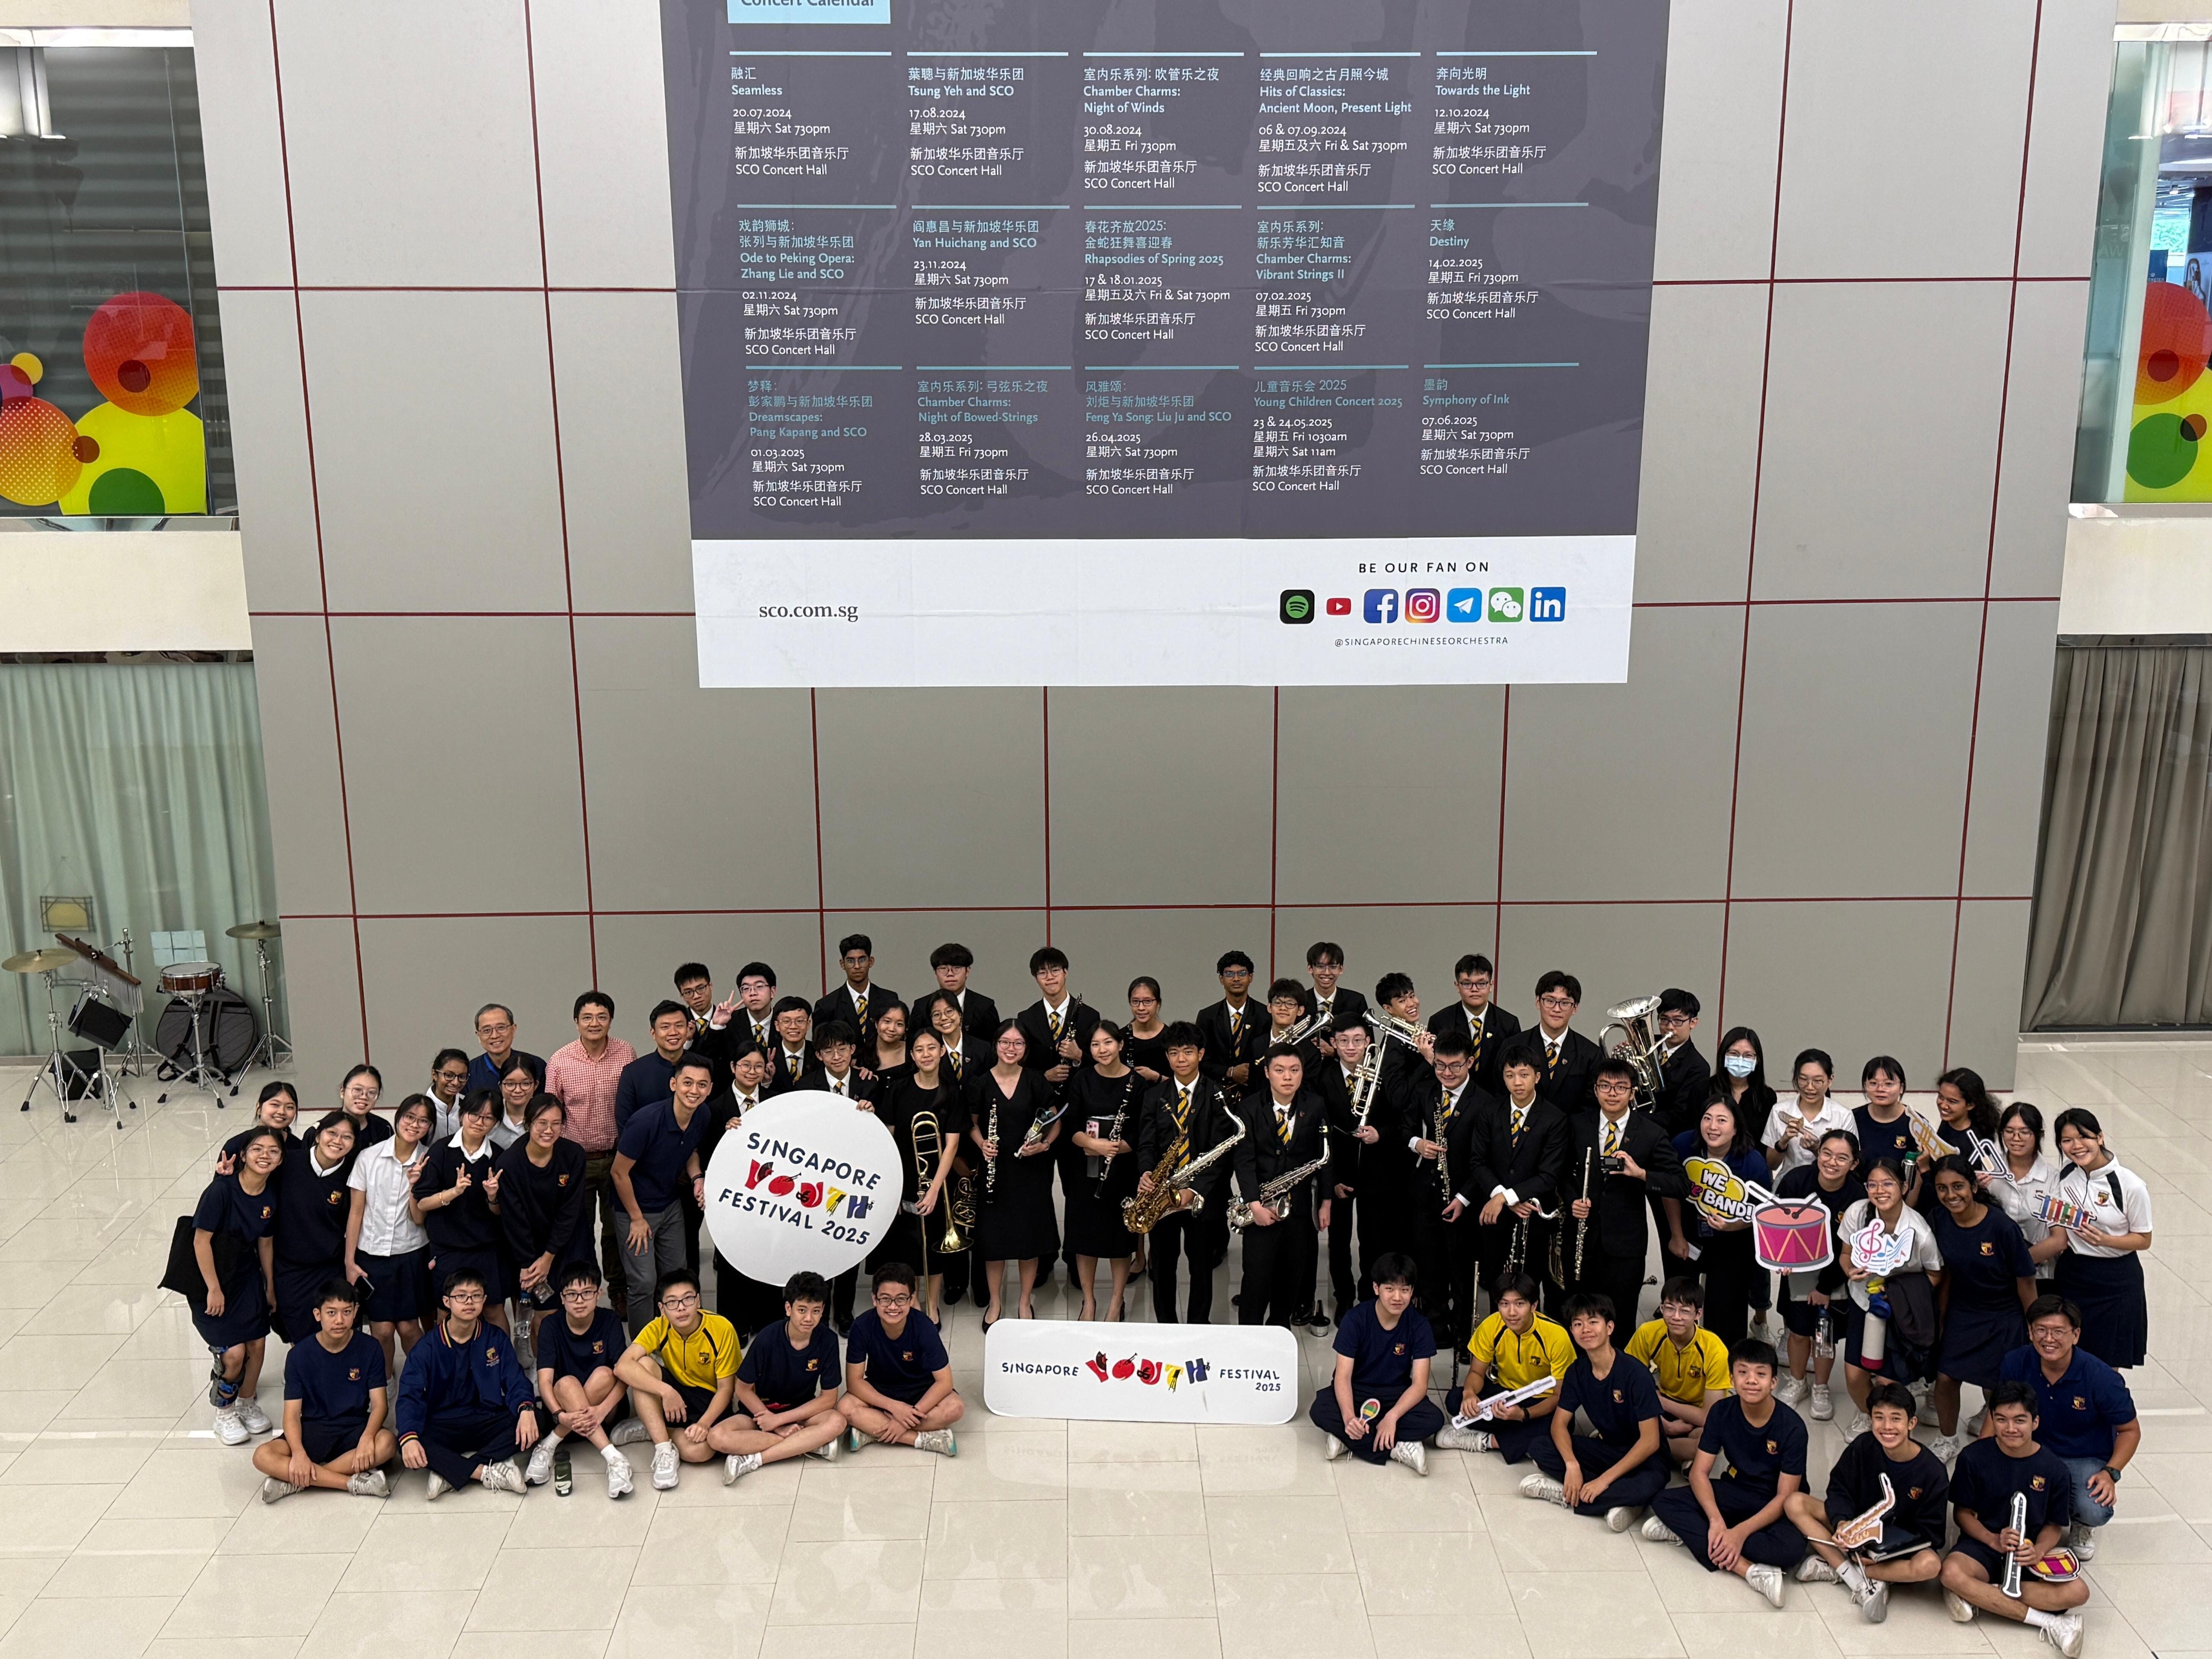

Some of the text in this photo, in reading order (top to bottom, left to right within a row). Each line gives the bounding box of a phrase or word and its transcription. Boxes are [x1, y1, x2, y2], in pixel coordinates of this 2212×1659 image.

[731, 67, 757, 80] 融汇
[1260, 67, 1389, 81] 经典回响之古月照今城
[1436, 67, 1487, 81] 奔向光明
[731, 83, 782, 95] Seamless
[908, 84, 1014, 99] Tsung Yeh and SCO
[1083, 85, 1180, 96] Chamber Charms:
[1260, 85, 1345, 97] Hits of Classics:
[1435, 83, 1531, 98] Towards the Light
[733, 109, 792, 120] 20.07.2024
[909, 107, 966, 121] 17.08.2024
[1084, 101, 1165, 116] Night of Winds
[1259, 101, 1412, 116] Ancient Moon, Present Light
[1435, 109, 1490, 120] 12.10.2024
[1084, 124, 1142, 137] 30.08.2024
[1259, 123, 1347, 137] 06 & 07.09.2024
[1084, 138, 1176, 154] 星期五 Fri 730pm
[1259, 138, 1407, 153] 星期五及六 Fri & Sat 730pm
[735, 146, 849, 160] 新加坡华乐团音乐厅
[736, 163, 827, 175] SCO Concert Hall
[1430, 218, 1455, 232] 天缘
[739, 235, 854, 248] 张列与新加坡华乐团
[912, 236, 1037, 251] Yan Huichang and SCO
[1085, 236, 1173, 249] 金蛇狂舞喜迎春
[1257, 235, 1345, 249] 新乐芳华汇知音
[1430, 235, 1469, 249] Destiny
[740, 252, 855, 266] Ode to Peking Opera:
[1085, 252, 1224, 267] Rhapsodies of Spring 2025
[1256, 252, 1351, 264] Chamber Charms:
[1429, 259, 1483, 270] 14.02.2025
[914, 261, 967, 271] 23.11.2024
[741, 267, 844, 282] Zhang Lie and SCO
[1085, 273, 1162, 287] 17 & 18.01.2025
[1256, 269, 1294, 280] Vibrant
[1297, 268, 1334, 282] Strings
[742, 291, 798, 302] 02.11.2024
[1255, 292, 1311, 303] 07.02.2025
[1319, 380, 1347, 390] 2025
[1424, 378, 1448, 391] 墨韵
[918, 396, 1011, 407] Chamber Charms:
[1254, 396, 1402, 410] Young Children Concert 2025
[1423, 394, 1510, 407] Symphony of Ink
[749, 412, 823, 424] Dreamscapes:
[918, 411, 1038, 425] Night of Bowed-Strings
[1086, 411, 1231, 425] Feng Ya Song: Liu Ju and SCO
[1253, 416, 1332, 429] 23 & 24.05.2025
[1422, 415, 1478, 427] 07.06.2025
[750, 426, 867, 439] Pang Kapang and SCO
[919, 432, 973, 445] 28.03.2025
[1086, 432, 1141, 444] 26.04.2025
[1253, 430, 1347, 444] 星期五 Fri 1030am
[750, 449, 805, 459] 01.03.2025
[1253, 445, 1289, 458] 星期六
[1292, 446, 1309, 457] Sat
[1252, 464, 1361, 477] 新加坡华乐团音乐厅
[1252, 480, 1339, 491] SCO Concert Hall
[1359, 562, 1488, 573] BE OUR FAN ON
[760, 606, 858, 623] sco.com.sg
[1335, 637, 1508, 647] @SINGAPORECHINESEORCHESTRA
[747, 1132, 881, 1190] SINGAPORE
[1701, 1169, 1728, 1192] WE
[744, 1159, 874, 1218] YOUTH
[1703, 1189, 1753, 1220] BAND!
[718, 1188, 870, 1245] FESTIVAL 2025
[1002, 1351, 1280, 1393] SINGAPORE YOUTH FESTIVAL
[1255, 1382, 1281, 1392] 2025
